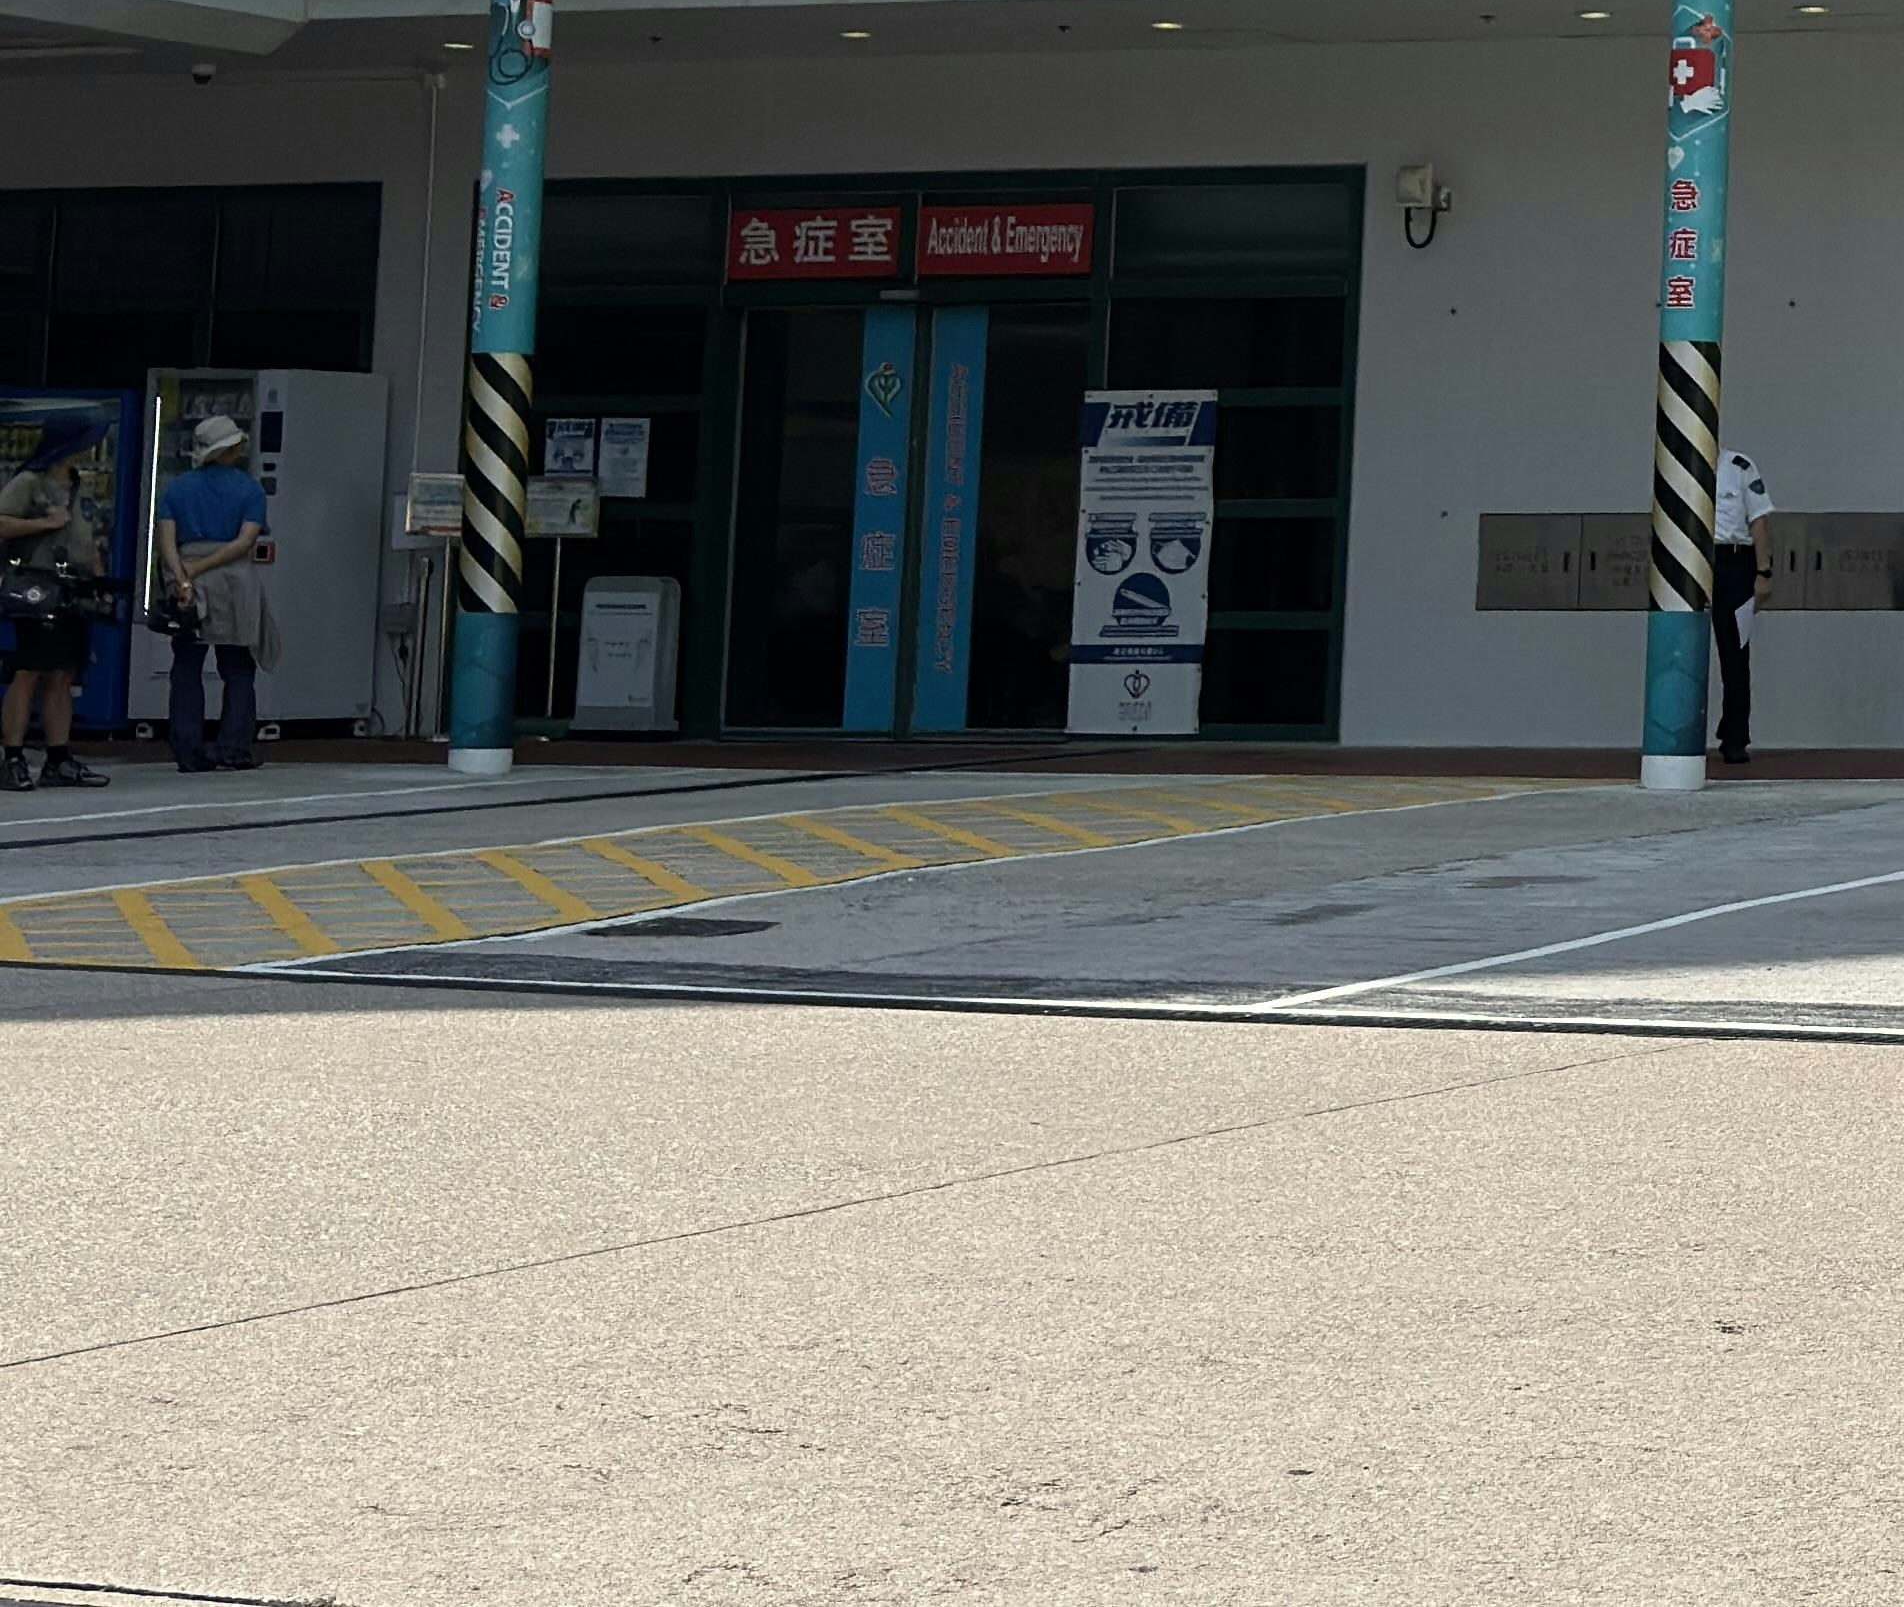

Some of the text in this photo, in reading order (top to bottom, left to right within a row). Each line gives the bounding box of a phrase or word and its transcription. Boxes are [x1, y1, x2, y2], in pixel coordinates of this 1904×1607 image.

[491, 188, 516, 289] ACCIDENT
[739, 216, 894, 266] 急症室
[927, 216, 1084, 264] Accident & Emergency
[1666, 178, 1700, 310] 急症室
